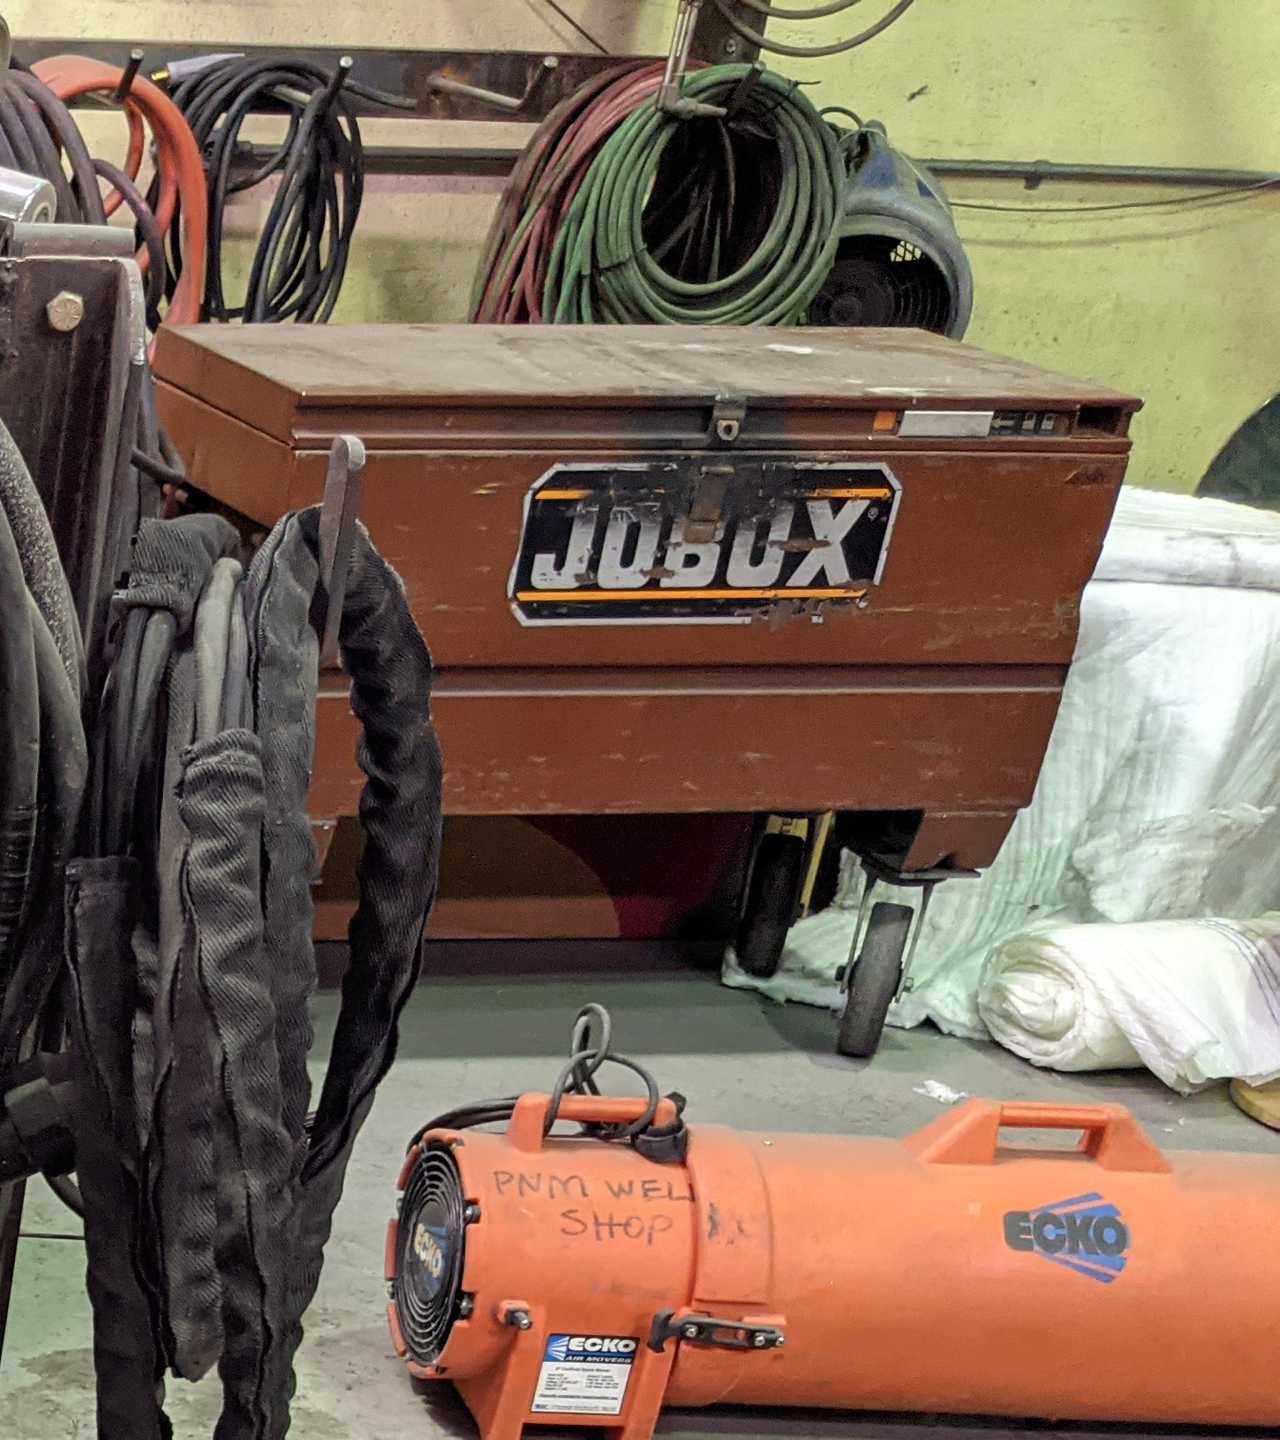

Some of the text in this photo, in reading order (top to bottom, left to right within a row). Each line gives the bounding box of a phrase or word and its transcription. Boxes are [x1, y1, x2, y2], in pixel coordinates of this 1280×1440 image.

[531, 499, 869, 589] JOBOX
[493, 1170, 589, 1200] PNM
[560, 1209, 673, 1246] SHOP
[1003, 1210, 1128, 1257] ECKO
[567, 1337, 637, 1353] ECKO
